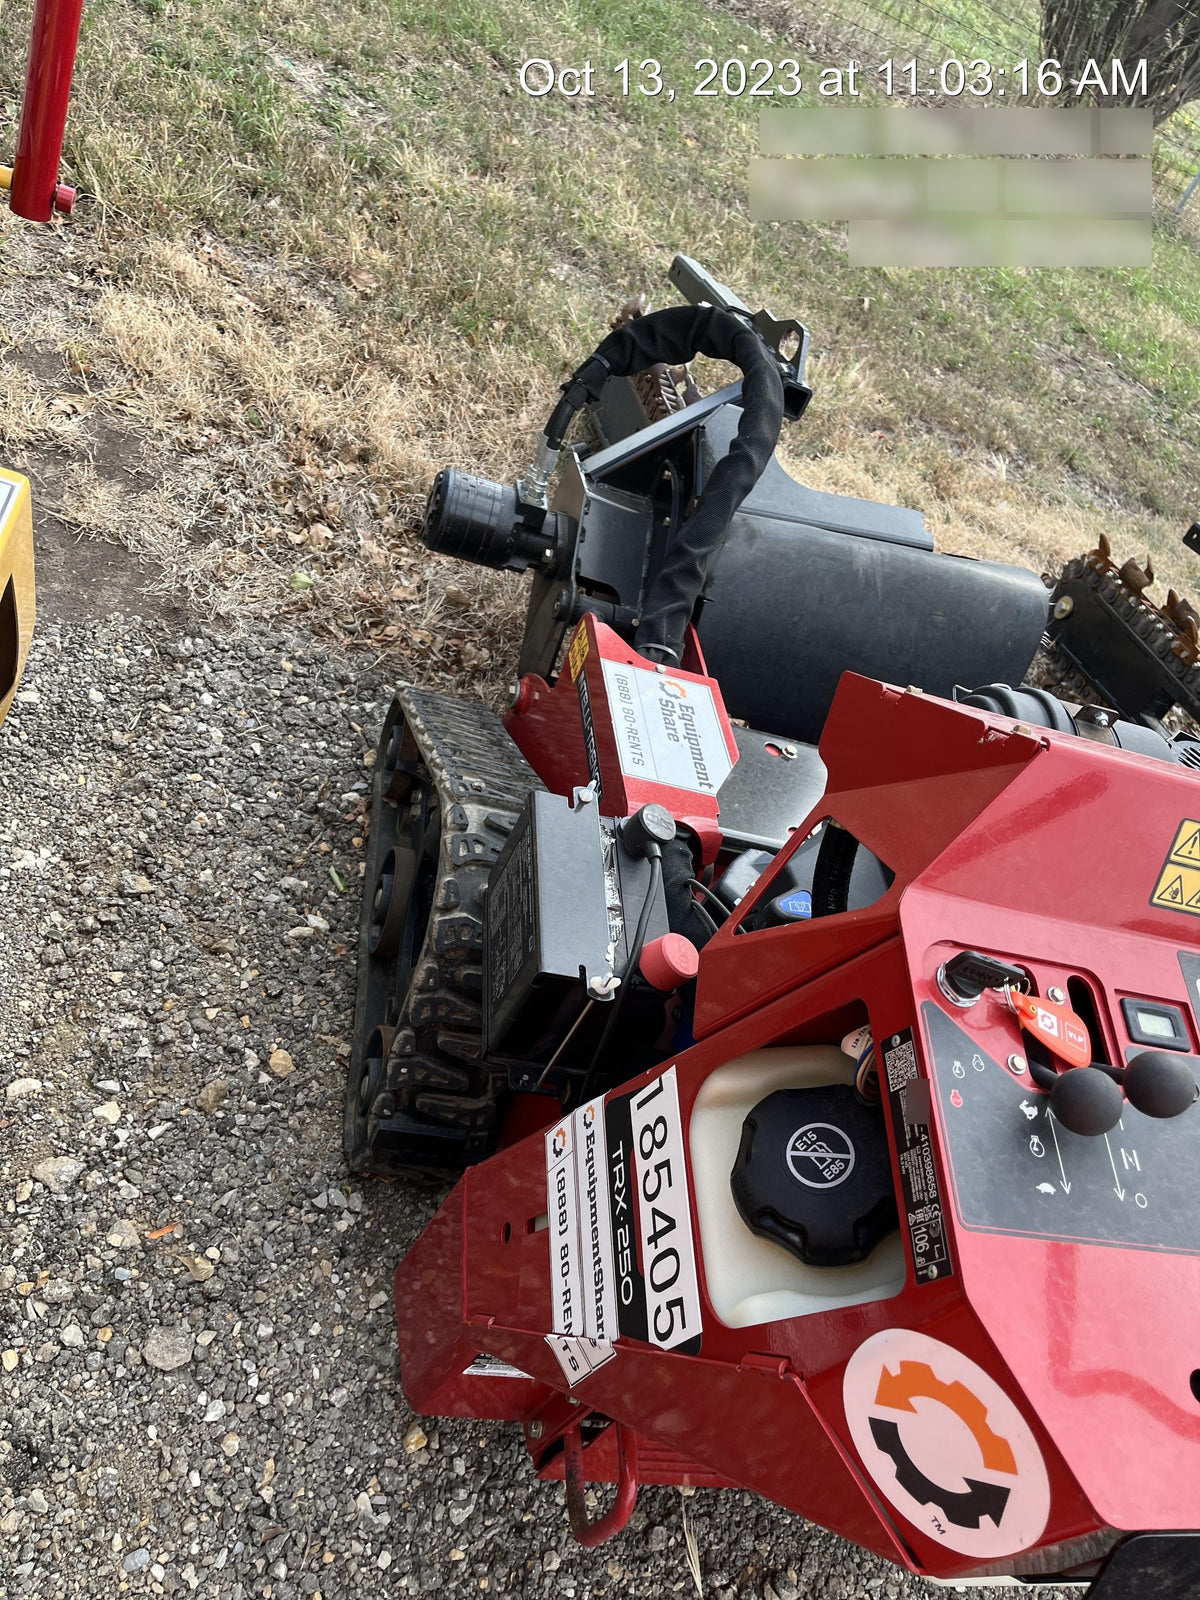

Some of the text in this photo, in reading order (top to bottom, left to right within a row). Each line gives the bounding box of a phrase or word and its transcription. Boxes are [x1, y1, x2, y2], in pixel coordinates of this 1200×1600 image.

[615, 673, 645, 766] (888) 80-RENTS
[659, 697, 680, 743] Share
[678, 702, 714, 790] Equipment
[1067, 1030, 1084, 1043] VLP
[795, 1131, 817, 1151] E15
[822, 1159, 845, 1180] E85
[556, 1167, 569, 1236] (888)
[636, 1076, 687, 1342] 185405
[913, 1226, 930, 1253] 106
[929, 1515, 947, 1535] TM
